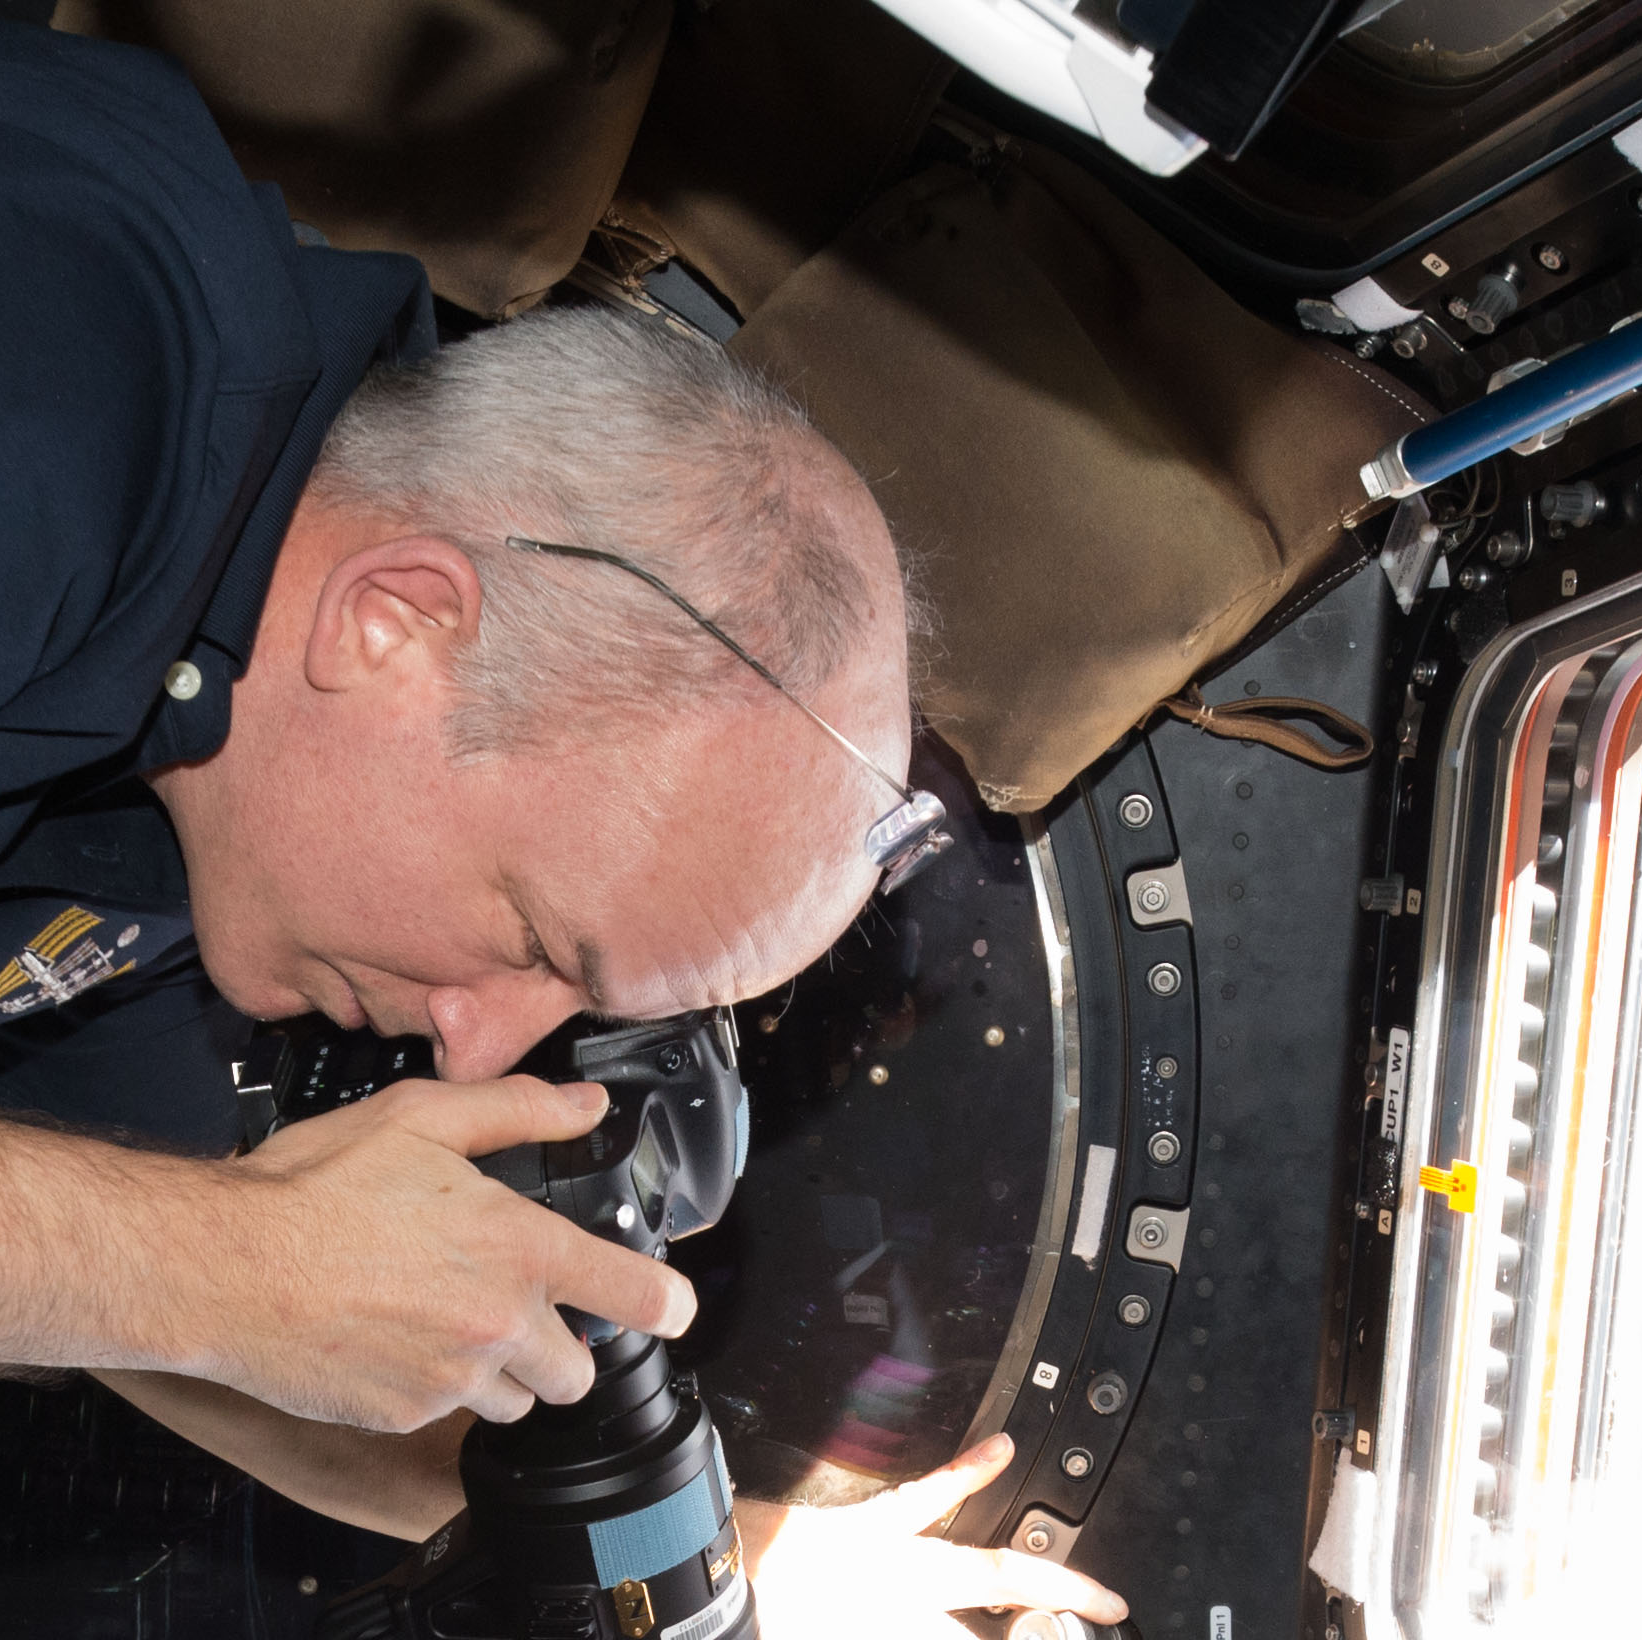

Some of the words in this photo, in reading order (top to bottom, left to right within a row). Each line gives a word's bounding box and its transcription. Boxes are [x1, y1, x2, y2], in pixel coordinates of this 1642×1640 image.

[1429, 259, 1443, 271] 8
[1563, 577, 1574, 589] 3
[1409, 897, 1418, 907] 2
[1385, 1042, 1403, 1141] CUP1_W1
[1039, 1370, 1053, 1382] 8
[1215, 1623, 1226, 1640] Pnl
